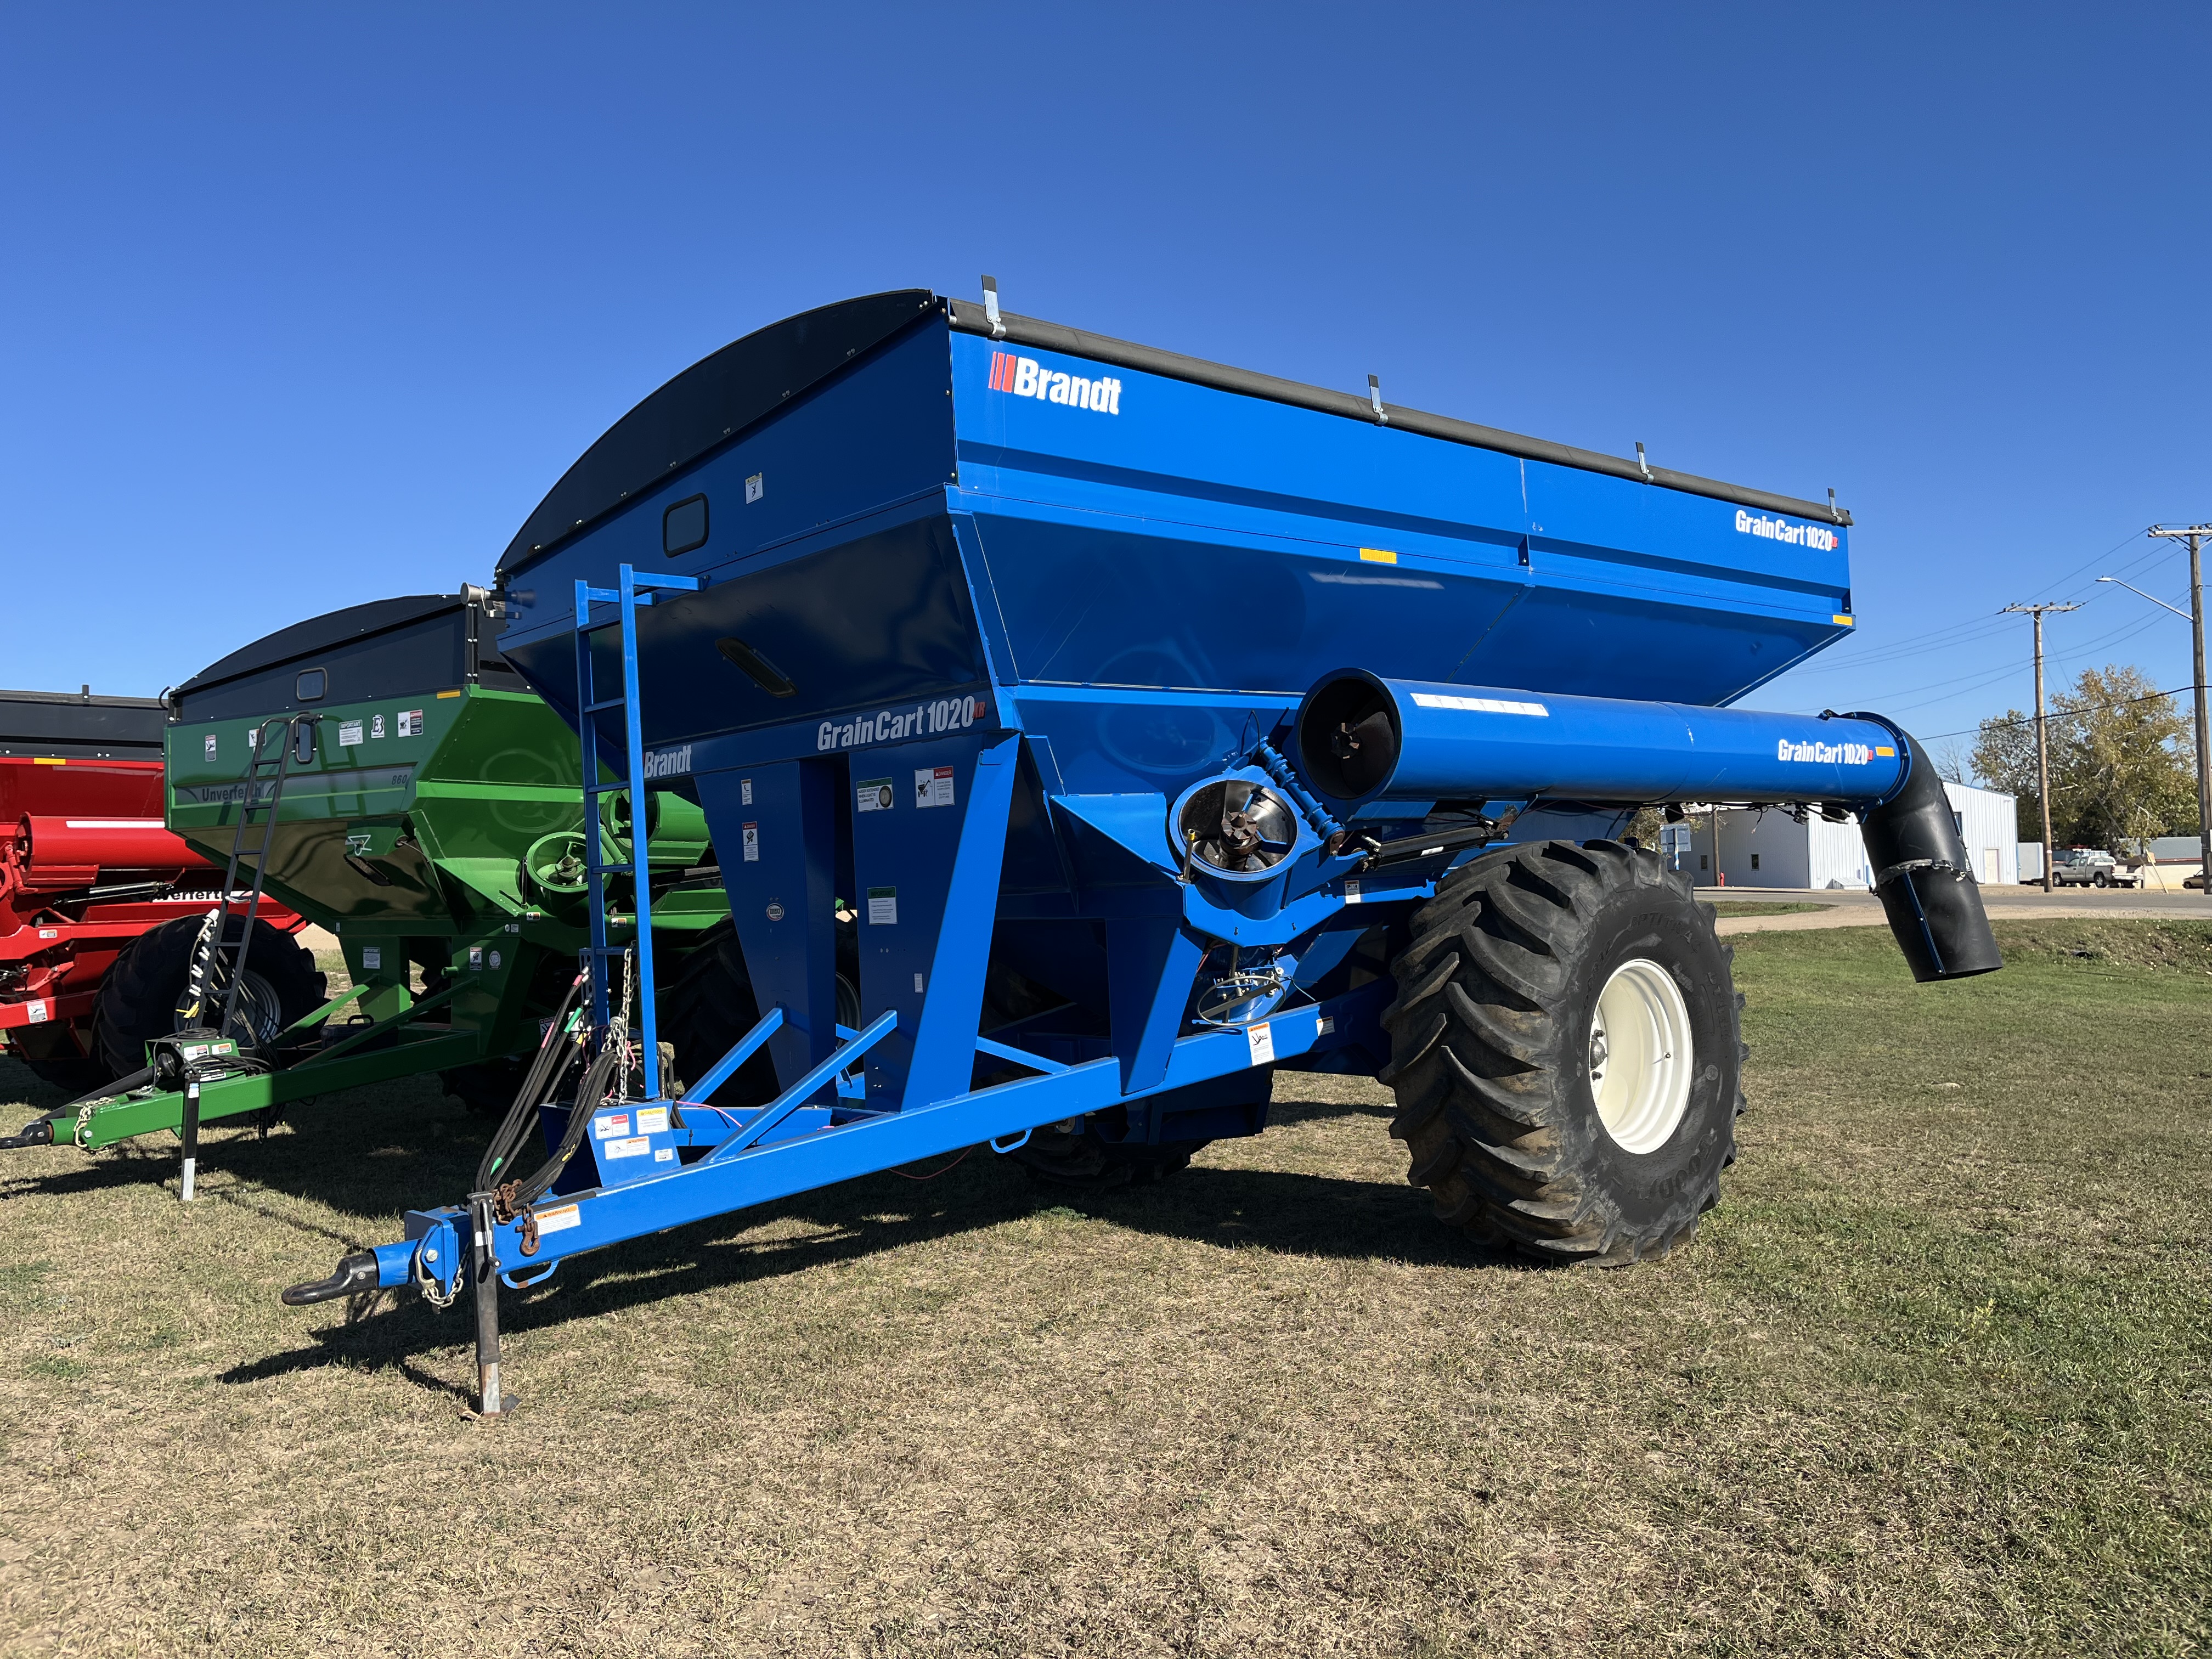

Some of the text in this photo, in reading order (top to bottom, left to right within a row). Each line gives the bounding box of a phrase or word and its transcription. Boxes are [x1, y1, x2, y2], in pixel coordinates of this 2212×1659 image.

[1014, 357, 1121, 415] Brandt
[644, 744, 692, 778] Brandt
[202, 783, 262, 802] Unverfeh
[391, 774, 408, 785] 860
